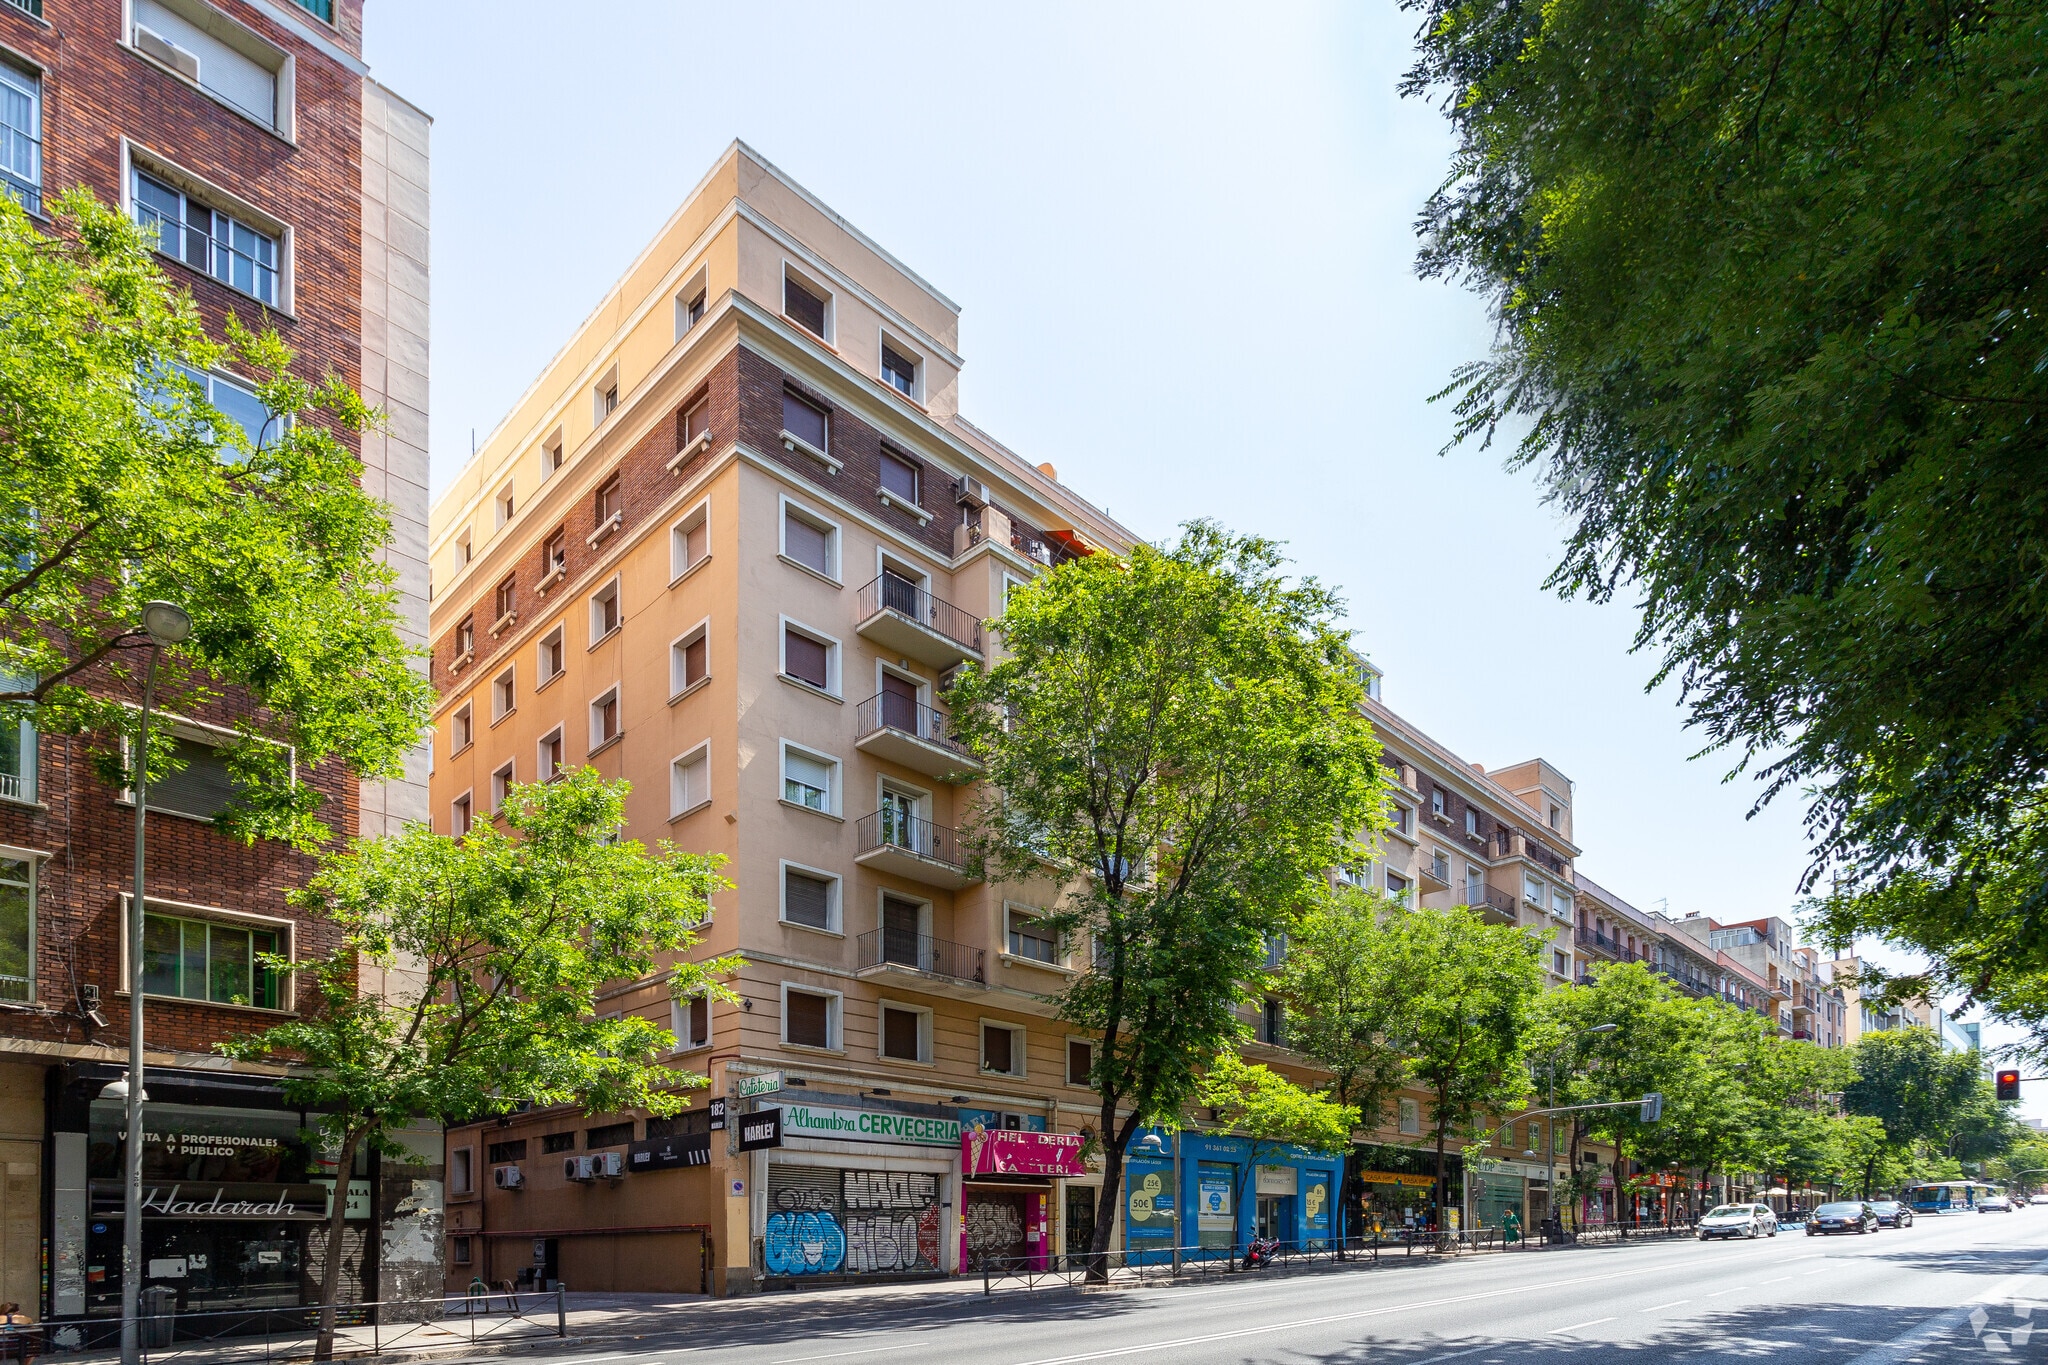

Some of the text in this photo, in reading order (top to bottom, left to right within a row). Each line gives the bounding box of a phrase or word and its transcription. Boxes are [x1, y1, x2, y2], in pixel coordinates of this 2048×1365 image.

[740, 1077, 779, 1097] Cafeteria
[710, 1103, 724, 1117] 182
[784, 1106, 961, 1141] Alhambra CERVECERIA
[118, 1131, 278, 1148] VTA A PROFESIONALES
[744, 1122, 775, 1143] HARLEY
[997, 1131, 1080, 1148] HELDERIA
[167, 1145, 234, 1157] Y PUBLICO
[141, 1183, 295, 1216] Hadarah
[1133, 1199, 1149, 1209] 50€
